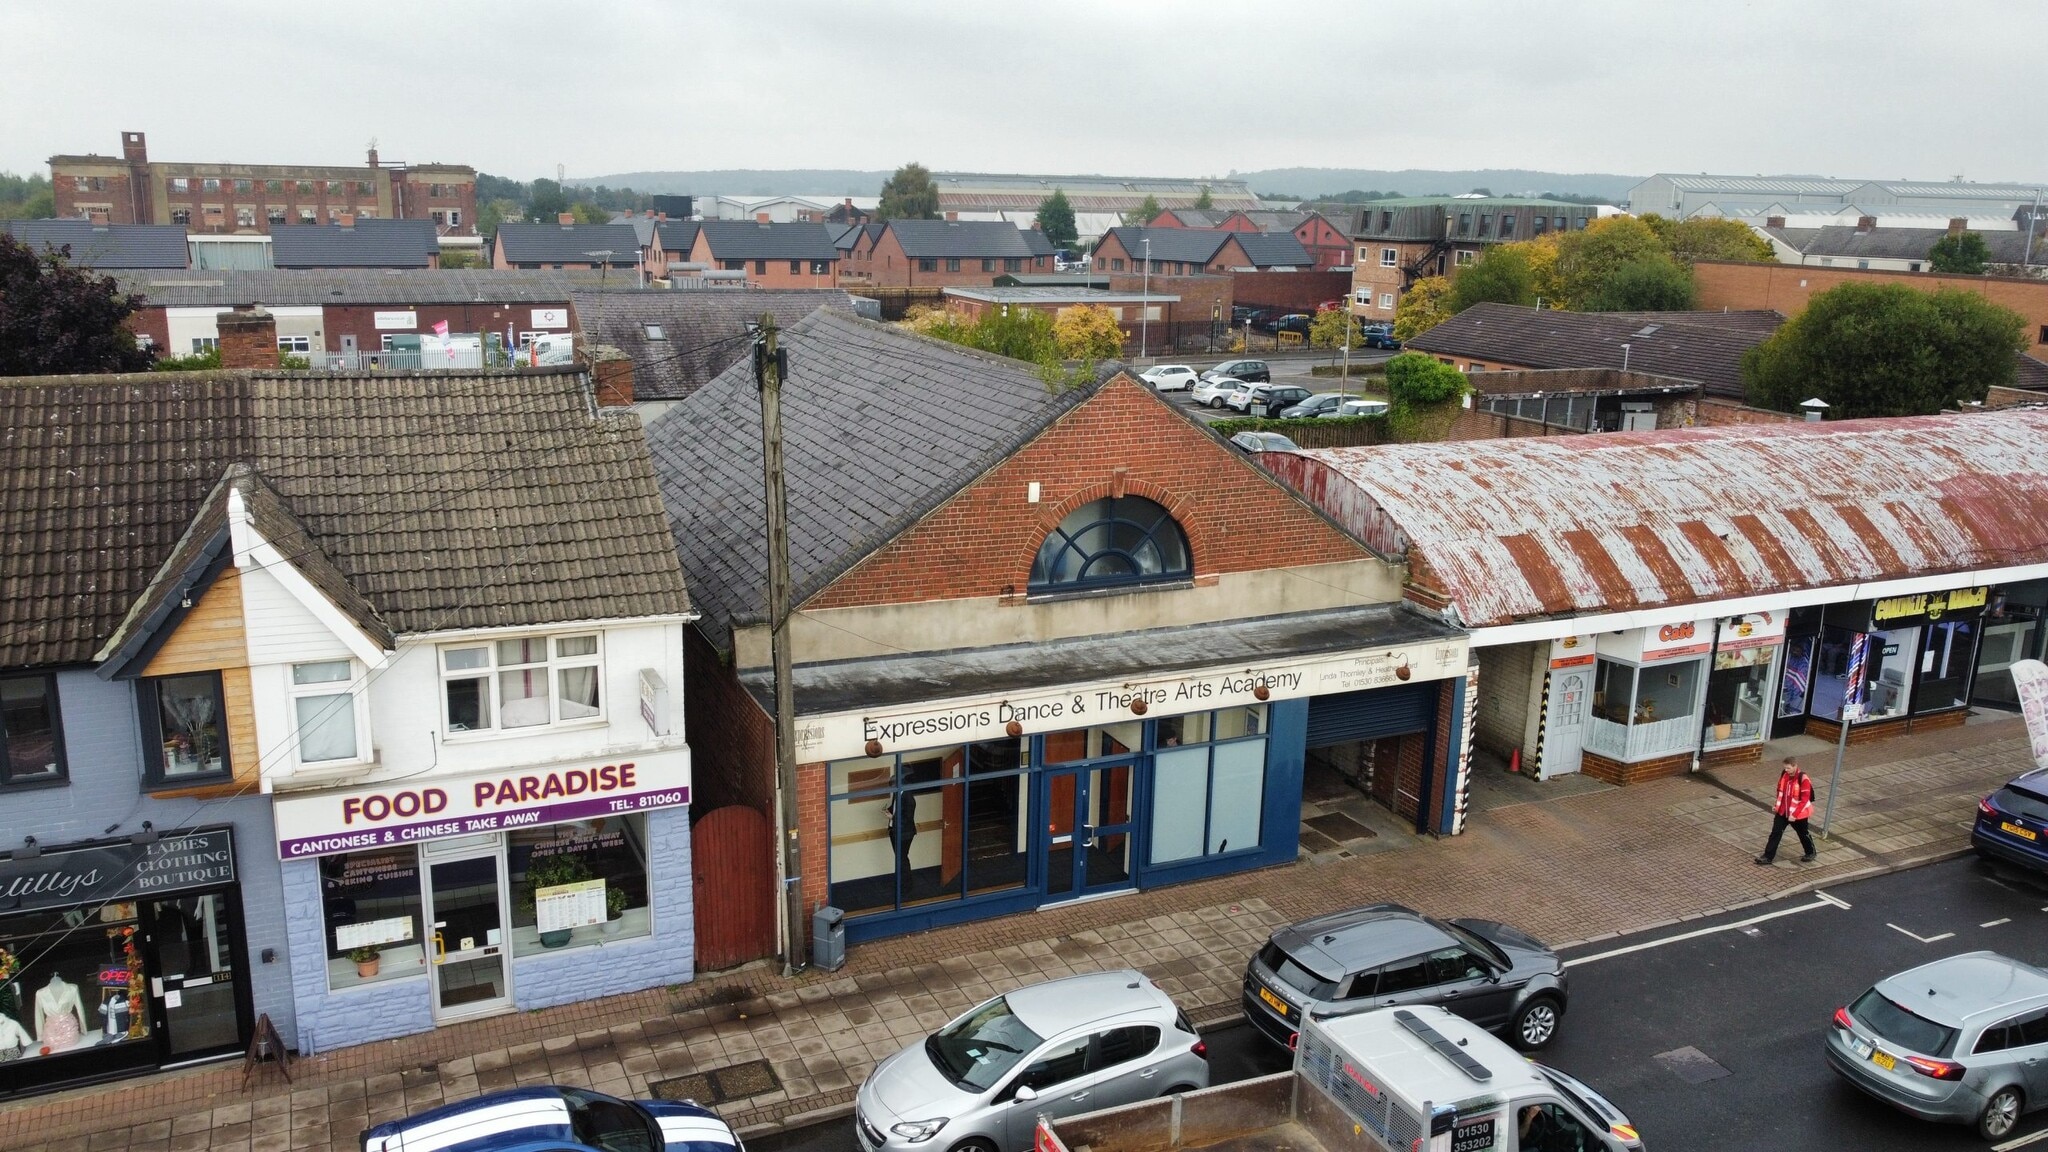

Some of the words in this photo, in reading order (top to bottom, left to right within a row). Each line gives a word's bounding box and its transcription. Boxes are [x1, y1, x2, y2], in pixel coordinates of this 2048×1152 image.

[1659, 621, 1696, 643] Café
[1881, 645, 1898, 655] OPEN
[1320, 671, 1337, 681] Linda
[1340, 669, 1366, 679] Thornley
[1368, 667, 1374, 675] &
[1353, 677, 1373, 687] 01530
[864, 710, 991, 743] Expressions
[998, 702, 1064, 725] Dance
[1071, 695, 1086, 714] &
[1095, 687, 1167, 711] Theatre
[1174, 680, 1212, 701] Arts
[1220, 670, 1303, 695] Academy
[343, 788, 449, 825] FOOD
[473, 762, 638, 808] PARADISE
[290, 830, 378, 856] CANTONESE
[384, 829, 395, 843] &
[400, 821, 460, 840] CHINESE
[464, 815, 498, 832] TAKE
[503, 810, 541, 827] AWAY
[609, 798, 634, 812] TEL:
[638, 791, 682, 808] 811060
[146, 836, 210, 857] LADIES
[531, 848, 555, 859] OPEN
[567, 843, 588, 853] DAYS
[602, 839, 625, 849] WEEK
[534, 838, 571, 851] CHINESE
[136, 850, 229, 873] CLOTHING
[343, 856, 396, 870] SPECIALIST
[343, 863, 398, 878] CANTONESE
[138, 865, 231, 889] BOUTIQUE
[339, 875, 374, 888] PEKING
[377, 868, 414, 882] CUISINE
[98, 970, 133, 982] OPEN
[1458, 1123, 1490, 1139] 01530
[1454, 1136, 1492, 1152] 353202
